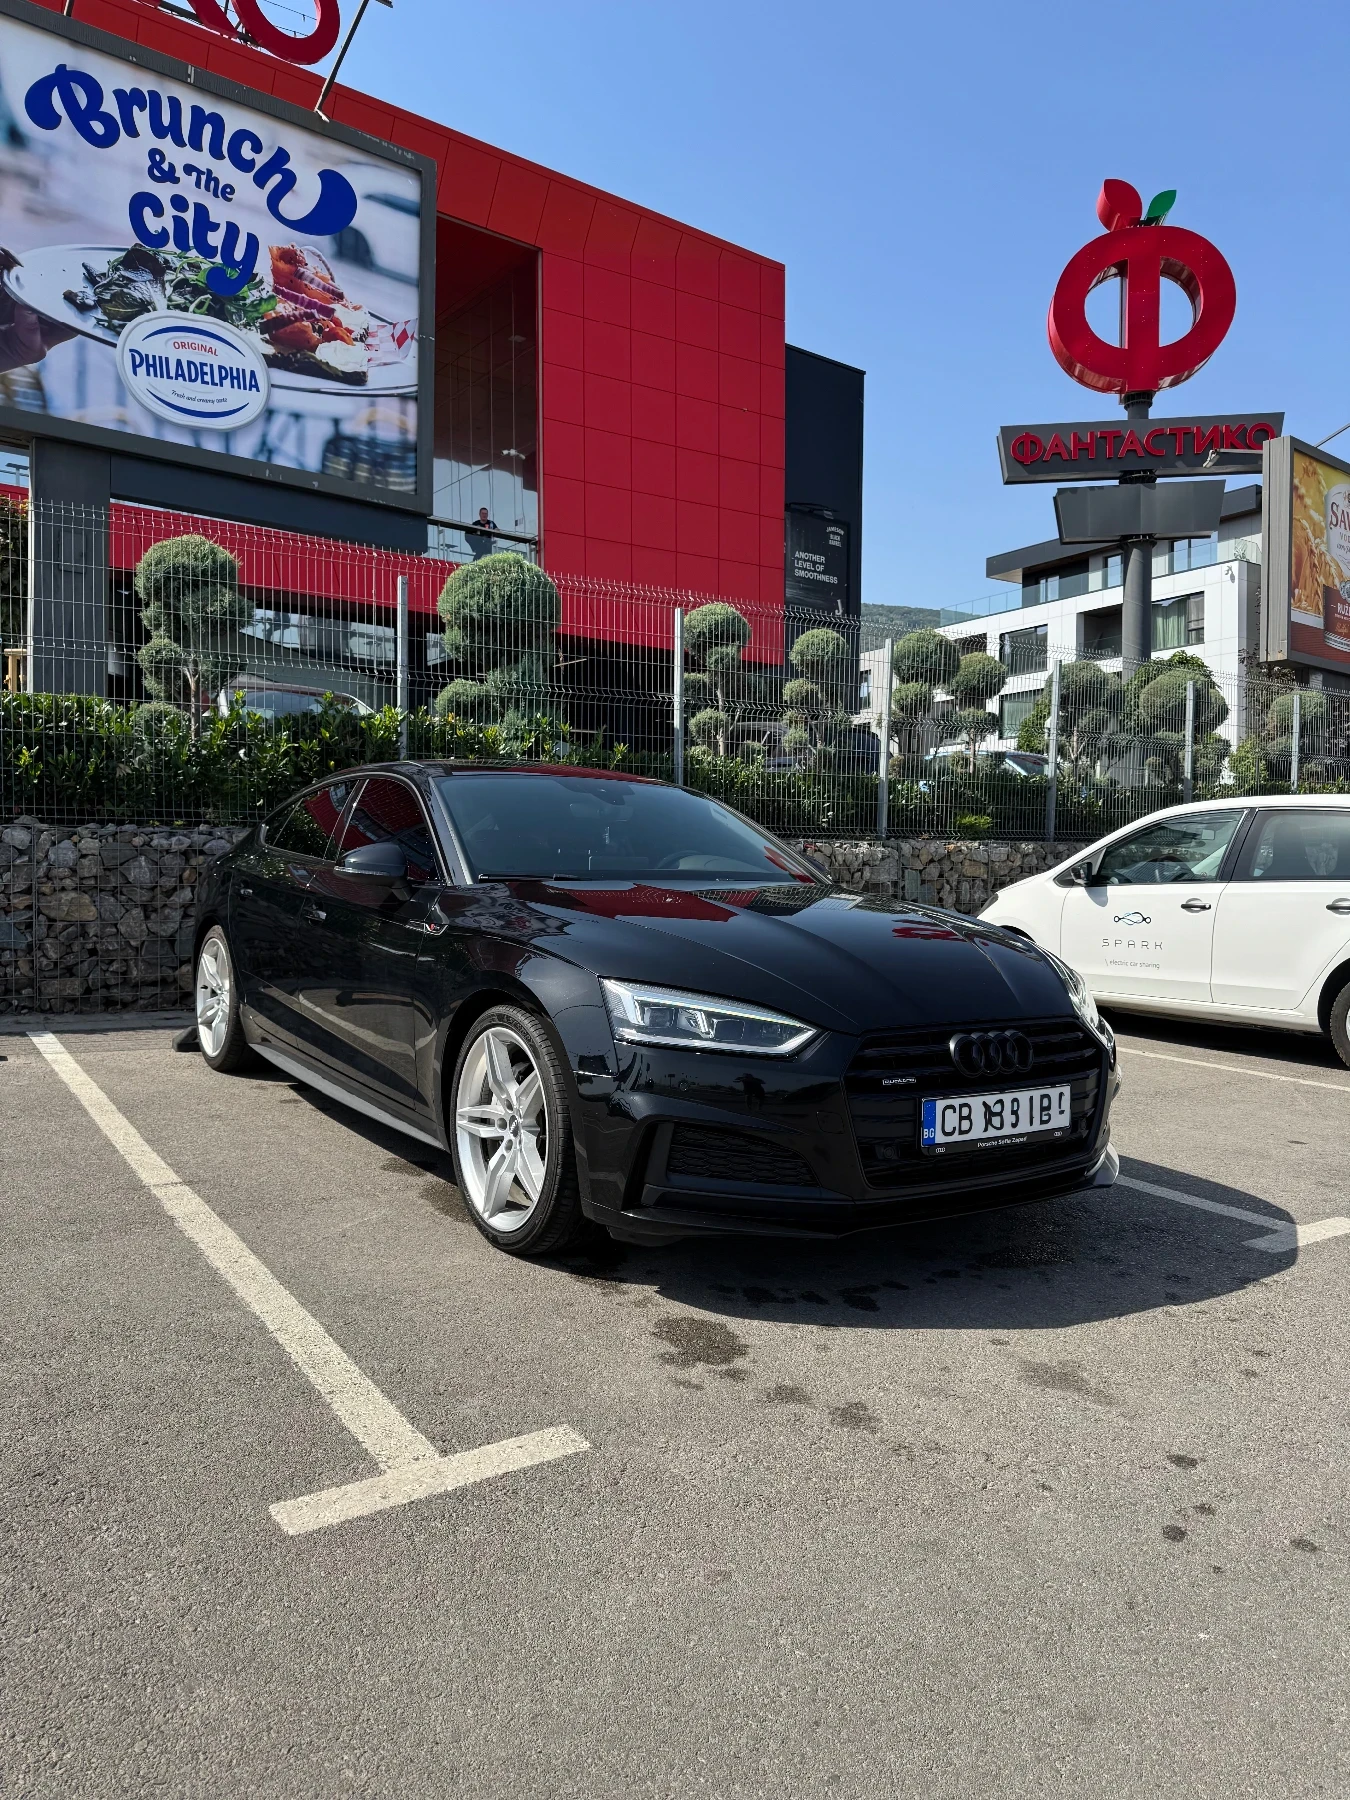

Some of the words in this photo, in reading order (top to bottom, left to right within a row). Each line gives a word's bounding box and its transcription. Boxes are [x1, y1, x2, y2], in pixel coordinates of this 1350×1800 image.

[24, 64, 357, 236] Brunch
[148, 148, 180, 184] &
[183, 163, 236, 202] The
[129, 191, 260, 296] City
[173, 341, 218, 357] ORIGINAL
[129, 348, 260, 393] PHILADELPHIA
[1010, 422, 1276, 465] ФАНТАСТИКО
[794, 551, 825, 563] ANOTHER
[794, 559, 814, 570] LEVEL
[815, 564, 825, 572] OF
[794, 569, 838, 584] SMOOTHNESS
[1102, 938, 1163, 950] SPARK
[1139, 962, 1160, 970] sharing
[941, 1102, 973, 1137] CB
[923, 1128, 935, 1139] BG
